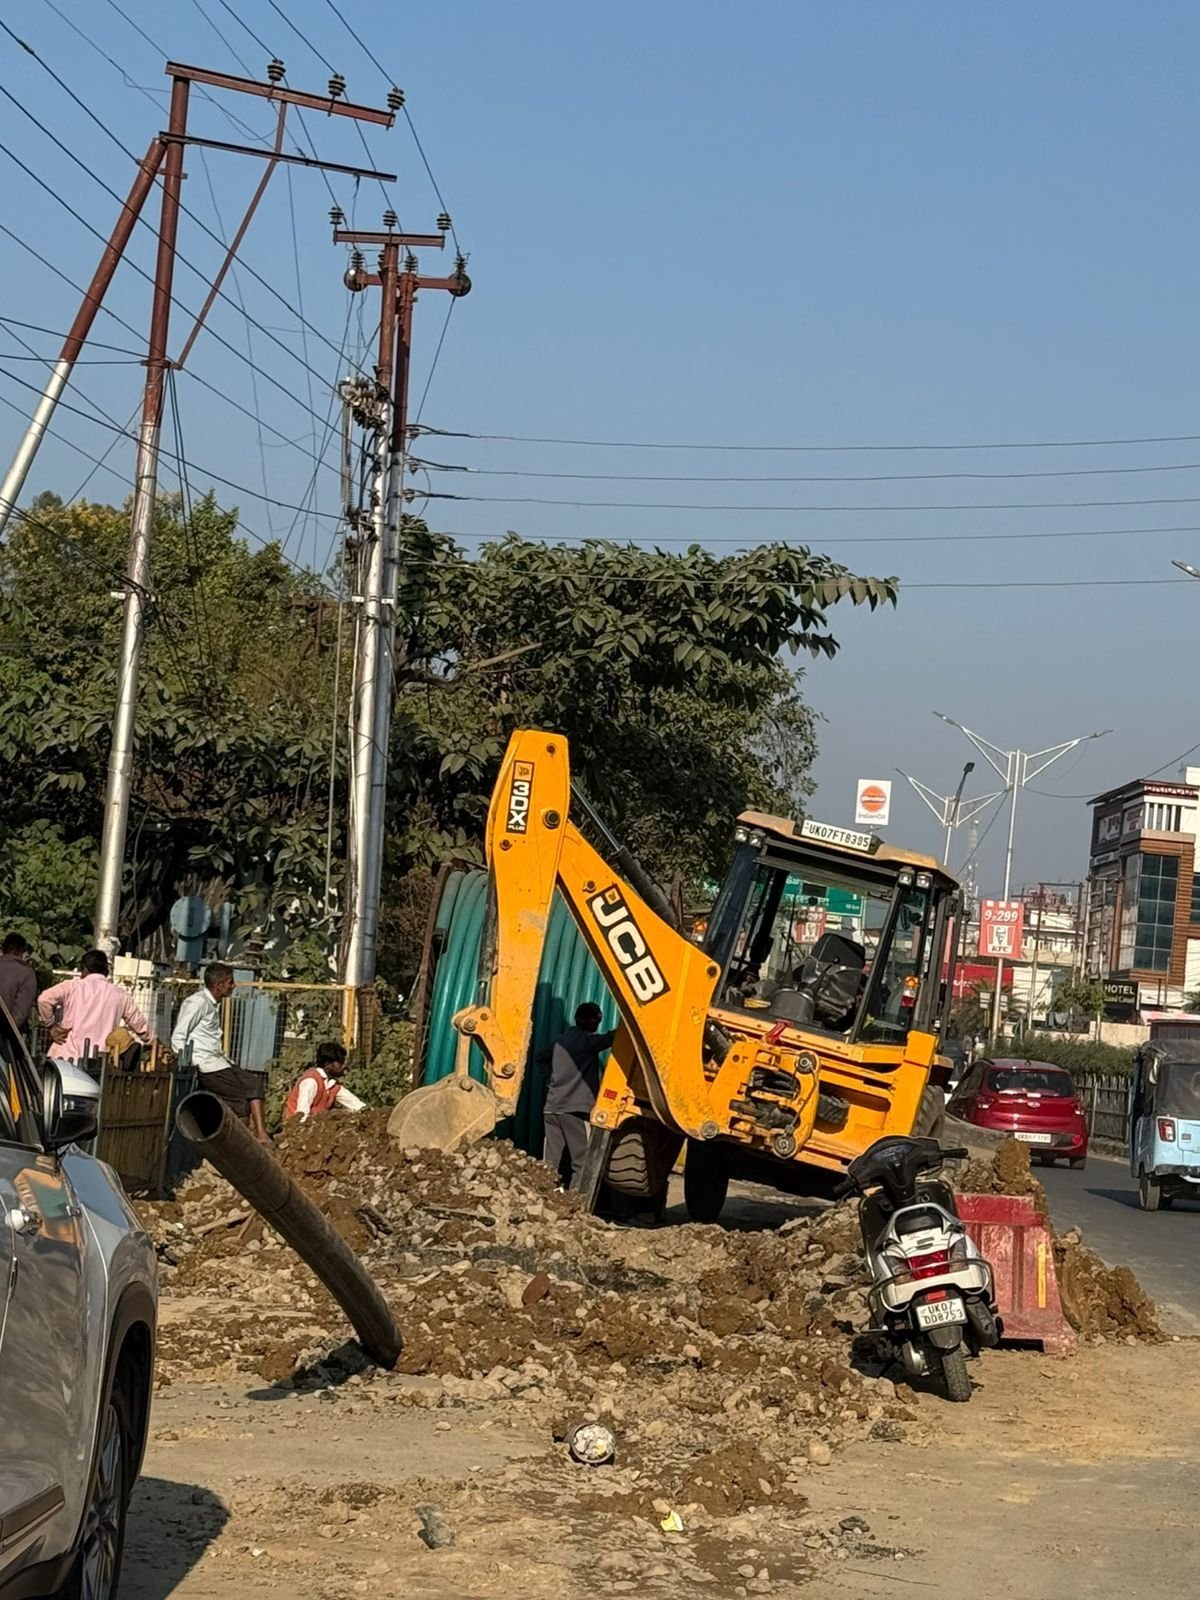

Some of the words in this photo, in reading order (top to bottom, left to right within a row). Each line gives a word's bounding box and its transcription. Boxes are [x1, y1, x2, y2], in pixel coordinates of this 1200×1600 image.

[508, 780, 530, 825] 3DX
[591, 896, 665, 1003] JCB
[1104, 983, 1136, 995] HOTEL
[927, 1301, 953, 1314] UK07
